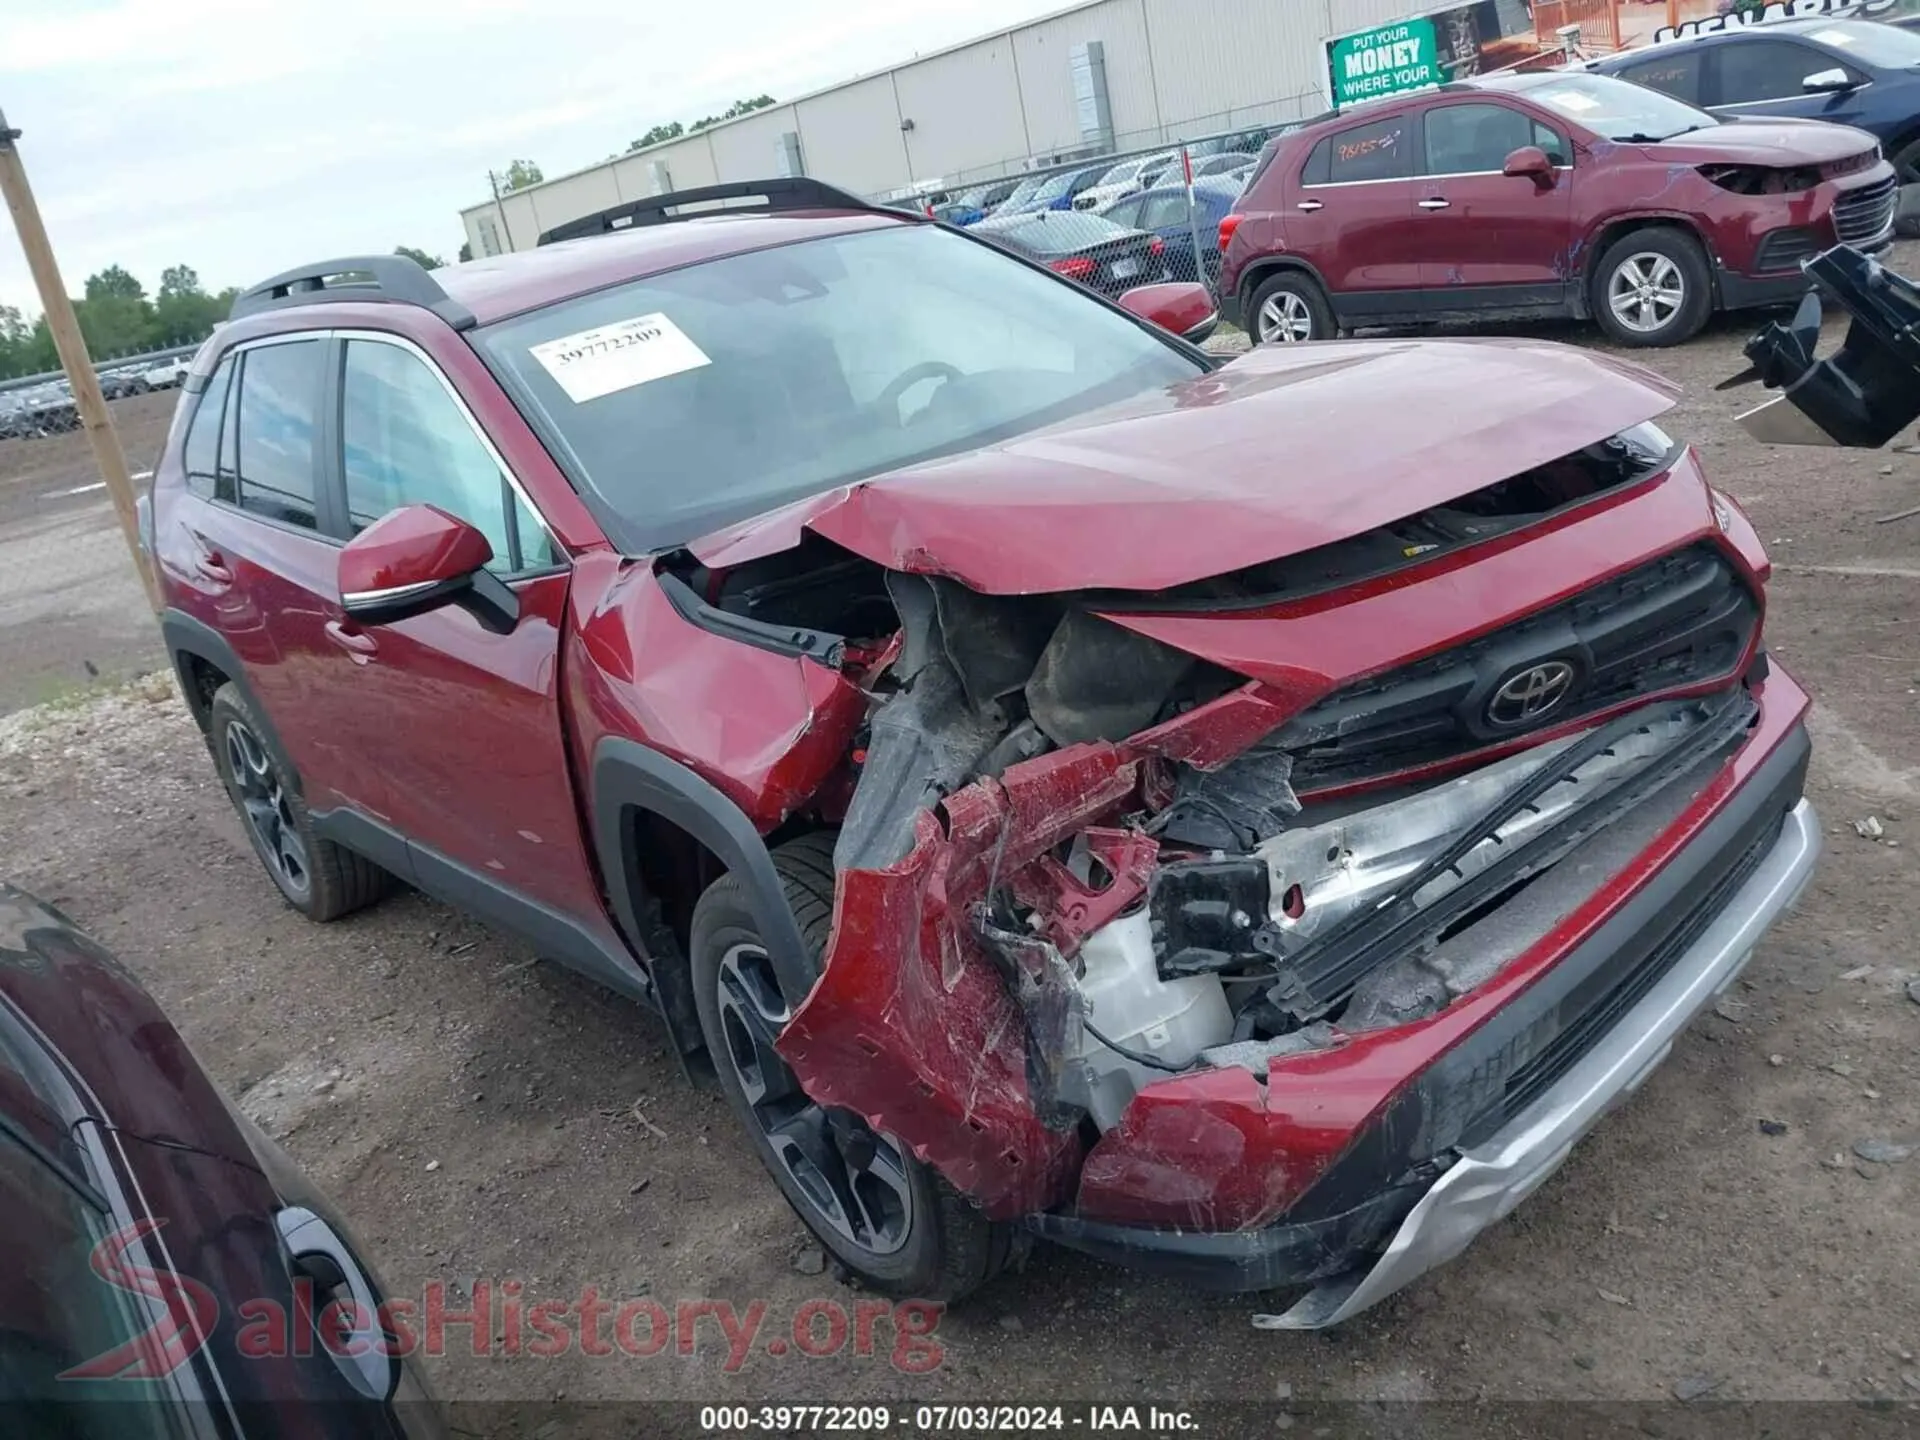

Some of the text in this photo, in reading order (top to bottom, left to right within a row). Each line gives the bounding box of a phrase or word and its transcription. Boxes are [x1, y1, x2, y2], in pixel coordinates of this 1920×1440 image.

[1353, 26, 1409, 50] PUT YOUR
[1344, 38, 1421, 79] MONEY
[1343, 74, 1392, 97] WHERE
[1393, 65, 1430, 85] YOUR
[555, 327, 663, 367] 39772209
